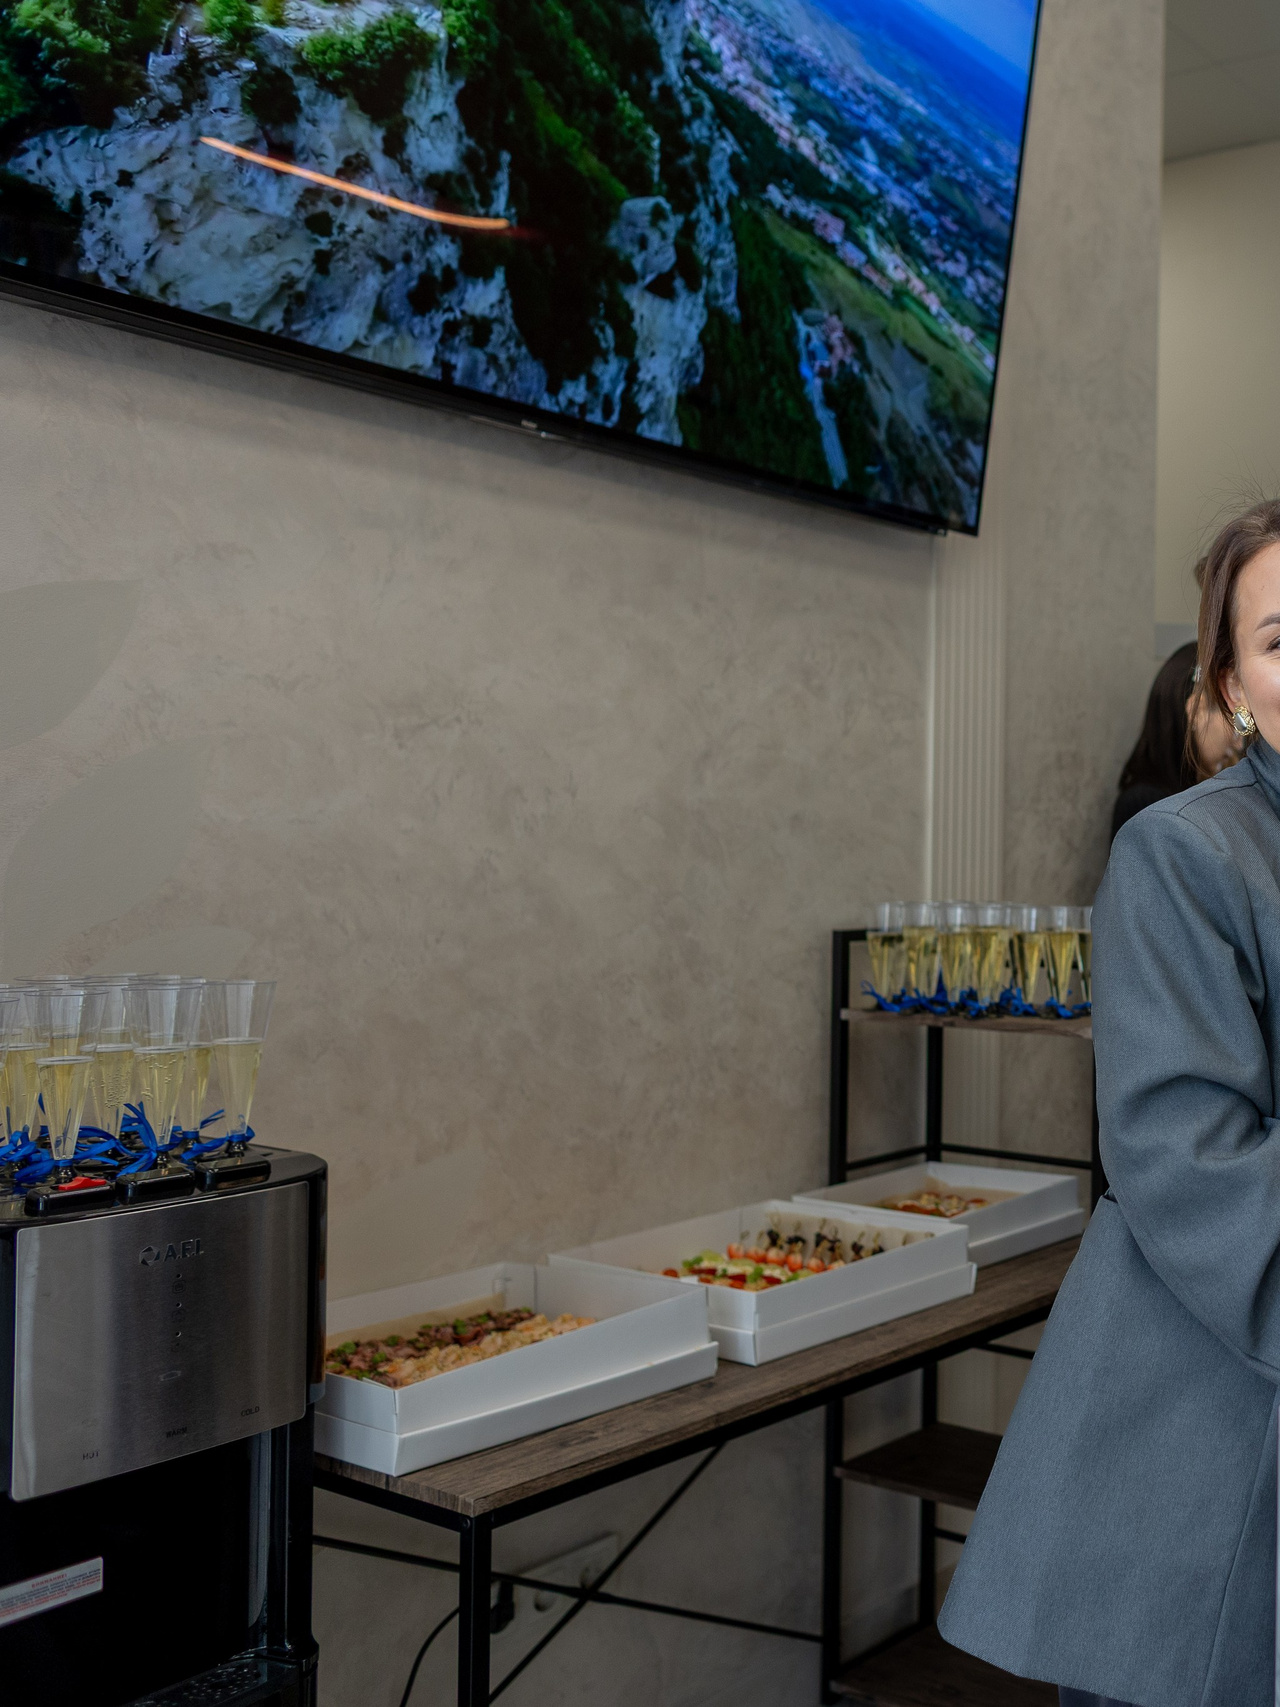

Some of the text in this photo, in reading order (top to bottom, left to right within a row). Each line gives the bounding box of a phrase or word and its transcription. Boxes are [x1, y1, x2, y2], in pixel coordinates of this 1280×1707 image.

[240, 1406, 260, 1418] COLD
[165, 1426, 188, 1439] WARM
[82, 1447, 100, 1461] HOT
